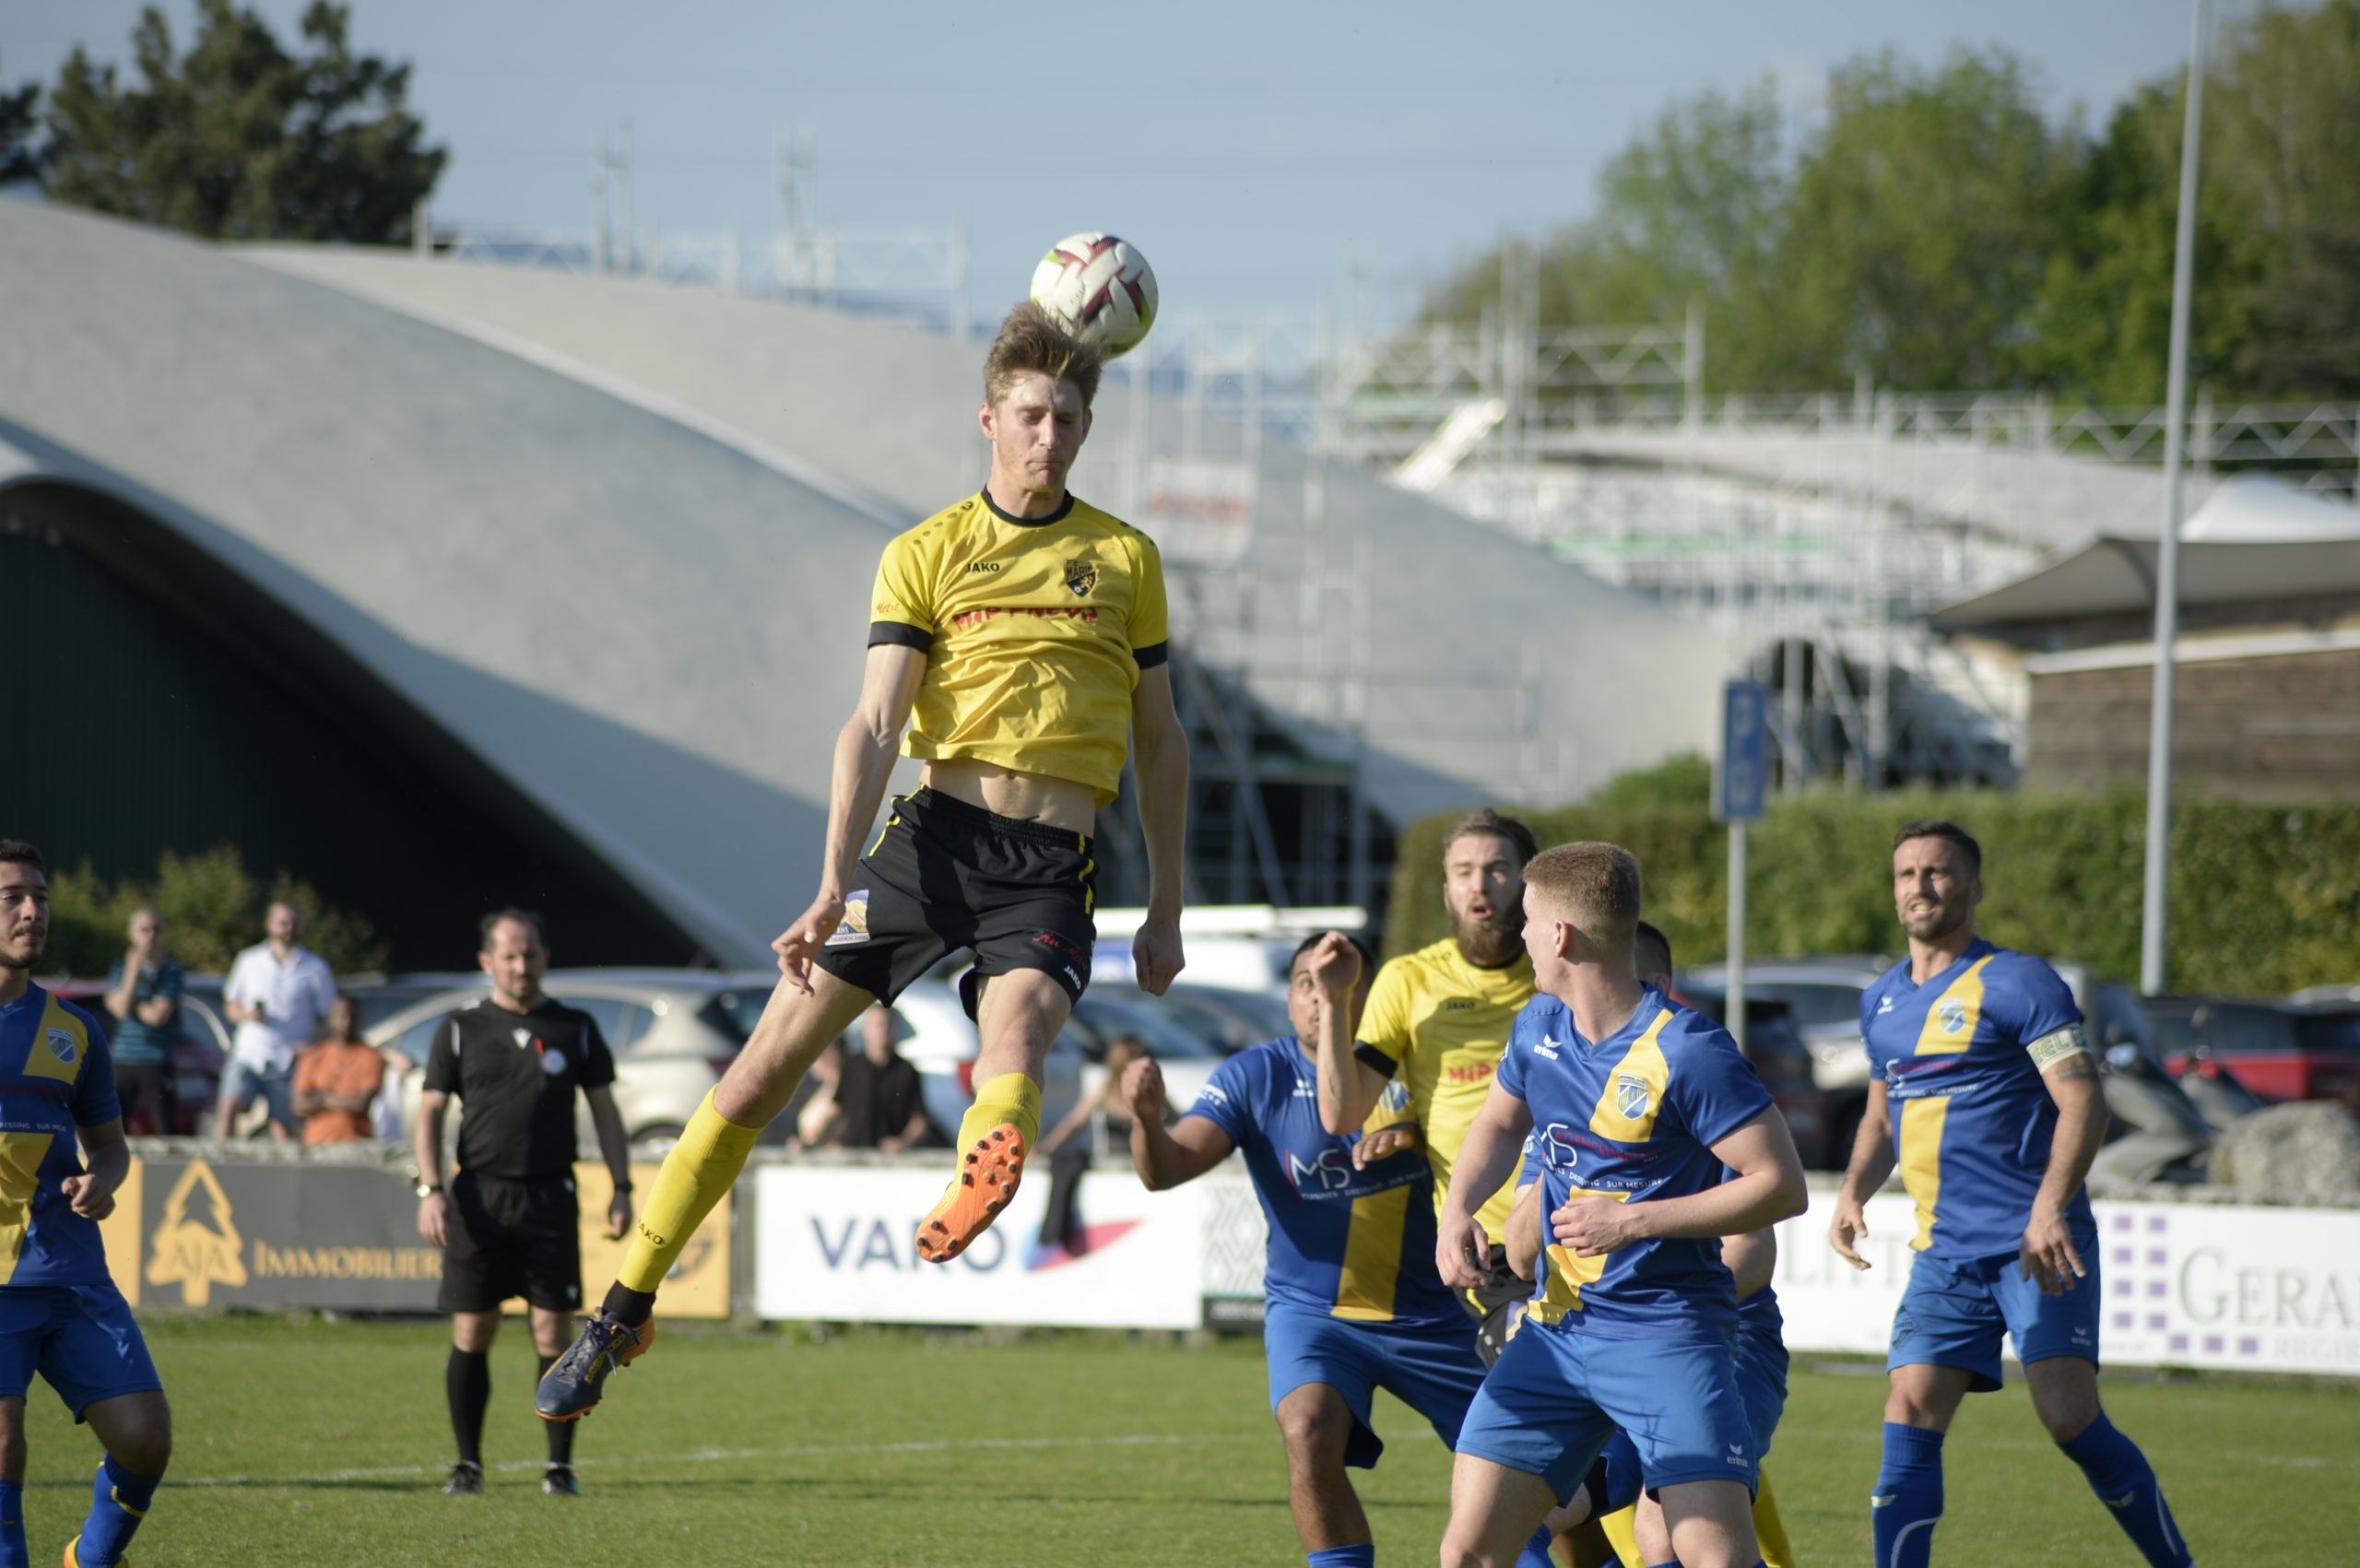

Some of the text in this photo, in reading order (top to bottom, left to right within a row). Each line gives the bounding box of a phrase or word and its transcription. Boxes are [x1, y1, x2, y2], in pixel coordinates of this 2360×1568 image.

[966, 562, 1000, 573] JAKO
[1067, 564, 1093, 583] MARIN
[1064, 965, 1081, 990] JAKO
[1446, 1000, 1475, 1010] JAKO
[1533, 1043, 1560, 1060] erima
[1606, 1180, 1624, 1188] SUR
[637, 1217, 665, 1245] AKO
[253, 1240, 443, 1280] IMMOBILIER
[1727, 1456, 1749, 1468] erima
